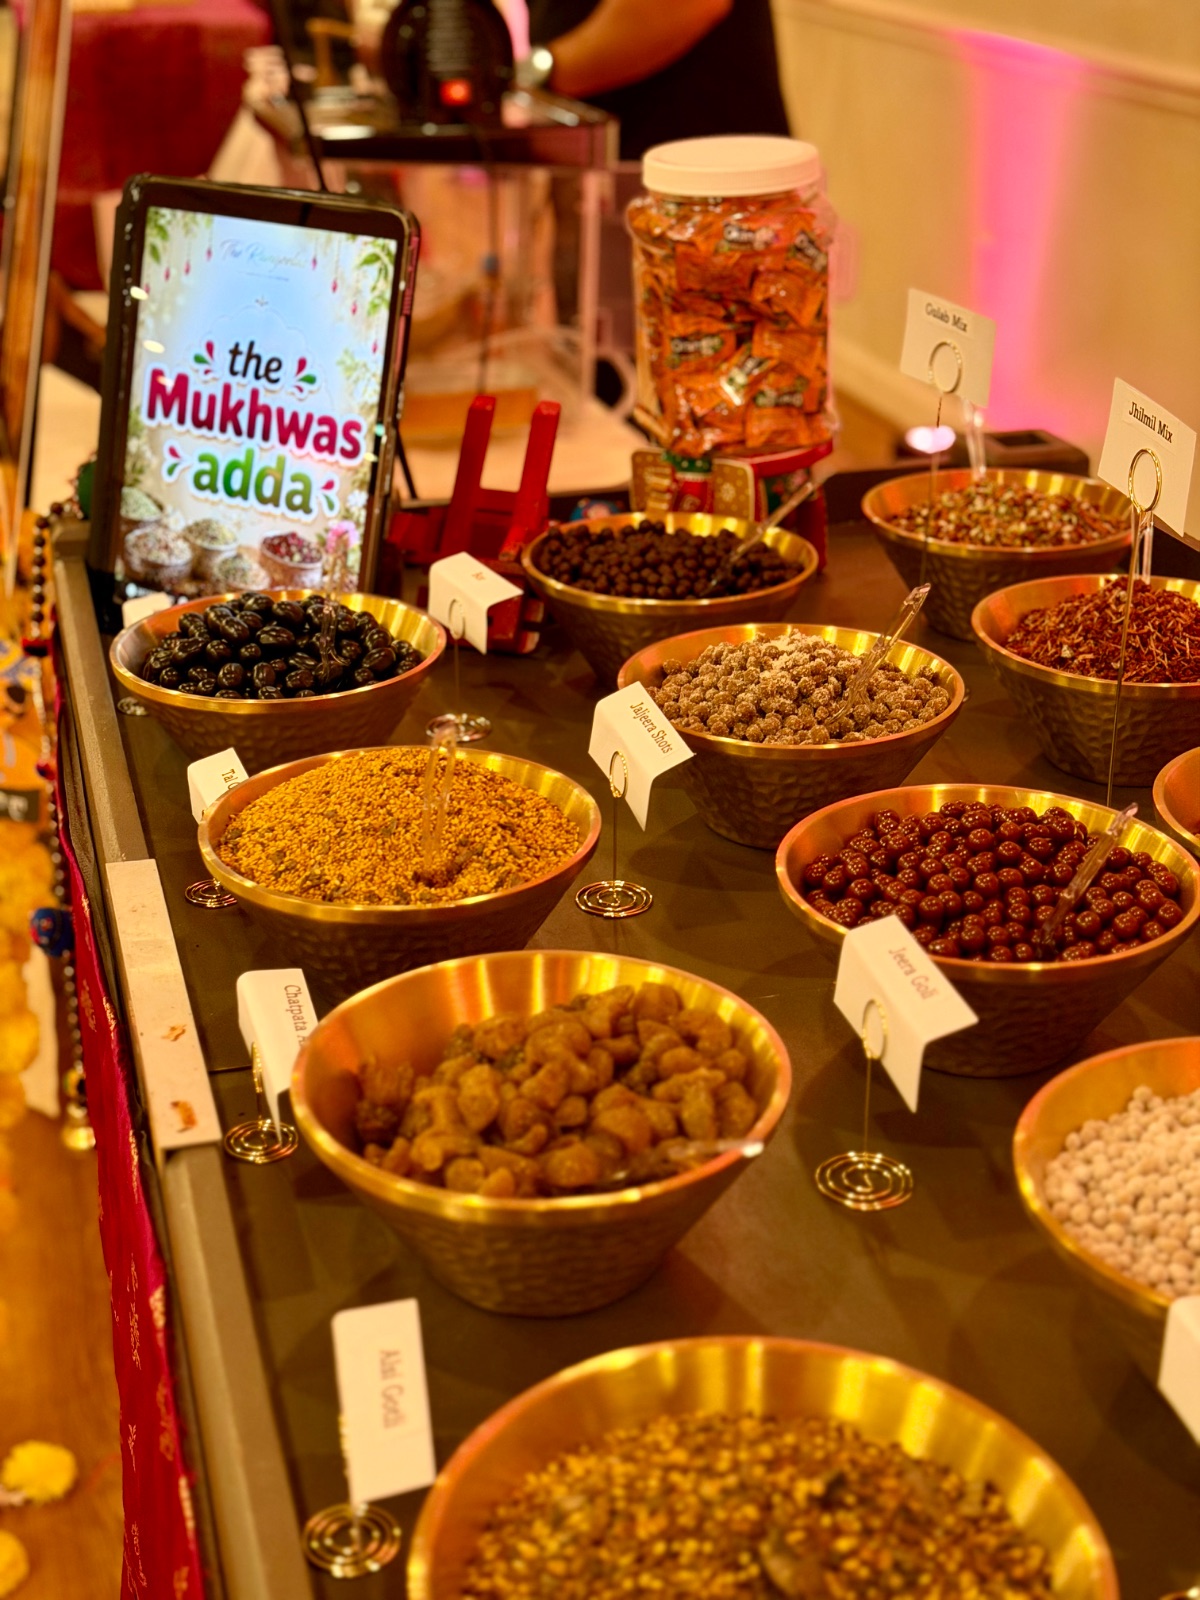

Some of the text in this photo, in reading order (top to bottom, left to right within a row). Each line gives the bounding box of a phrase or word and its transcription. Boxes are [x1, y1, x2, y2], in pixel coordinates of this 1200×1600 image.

[952, 315, 968, 332] Mix
[228, 340, 283, 384] the
[147, 367, 363, 460] Mukhwas
[1129, 402, 1173, 442] Jhilmil Mix
[192, 447, 313, 515] adda
[630, 701, 673, 754] Jaljeera Shots
[222, 769, 238, 783] Tal
[888, 947, 940, 1000] Jeera Goli
[284, 984, 308, 1032] Chatpata
